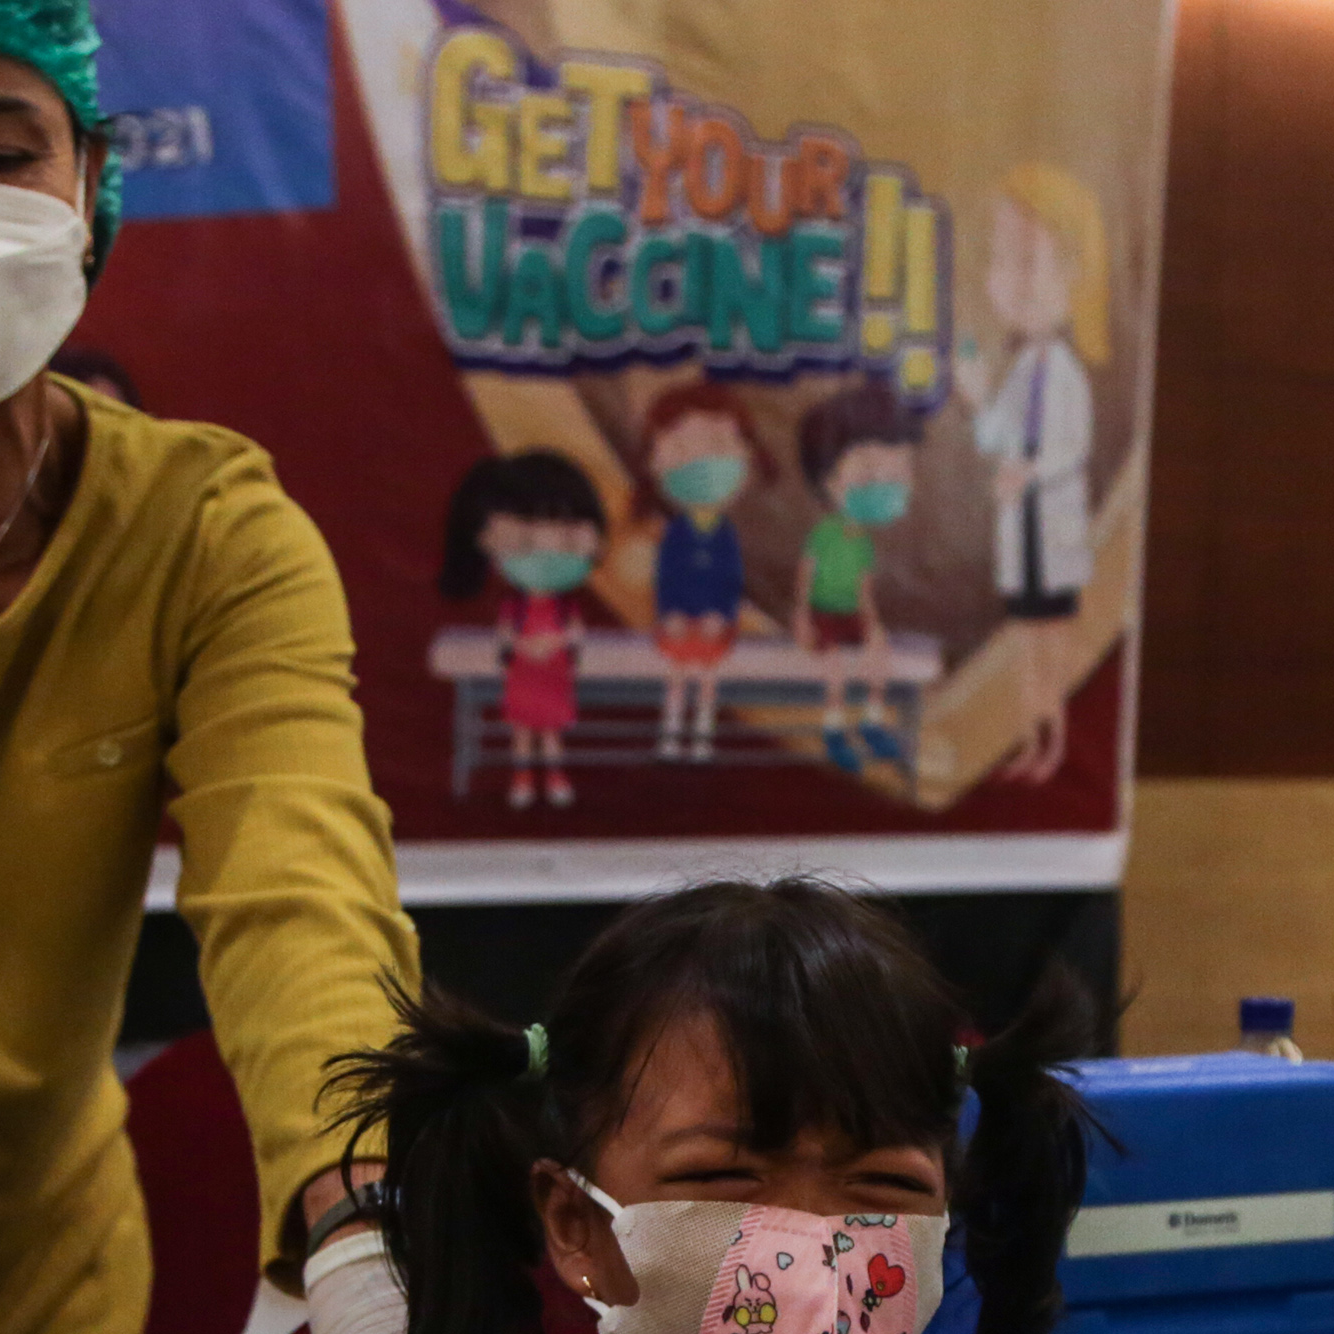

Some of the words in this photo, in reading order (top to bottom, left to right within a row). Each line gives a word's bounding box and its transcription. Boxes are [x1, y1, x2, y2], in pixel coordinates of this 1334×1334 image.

[431, 32, 651, 199] GET
[628, 96, 850, 236] YOUR
[439, 198, 844, 352] VACCINE
